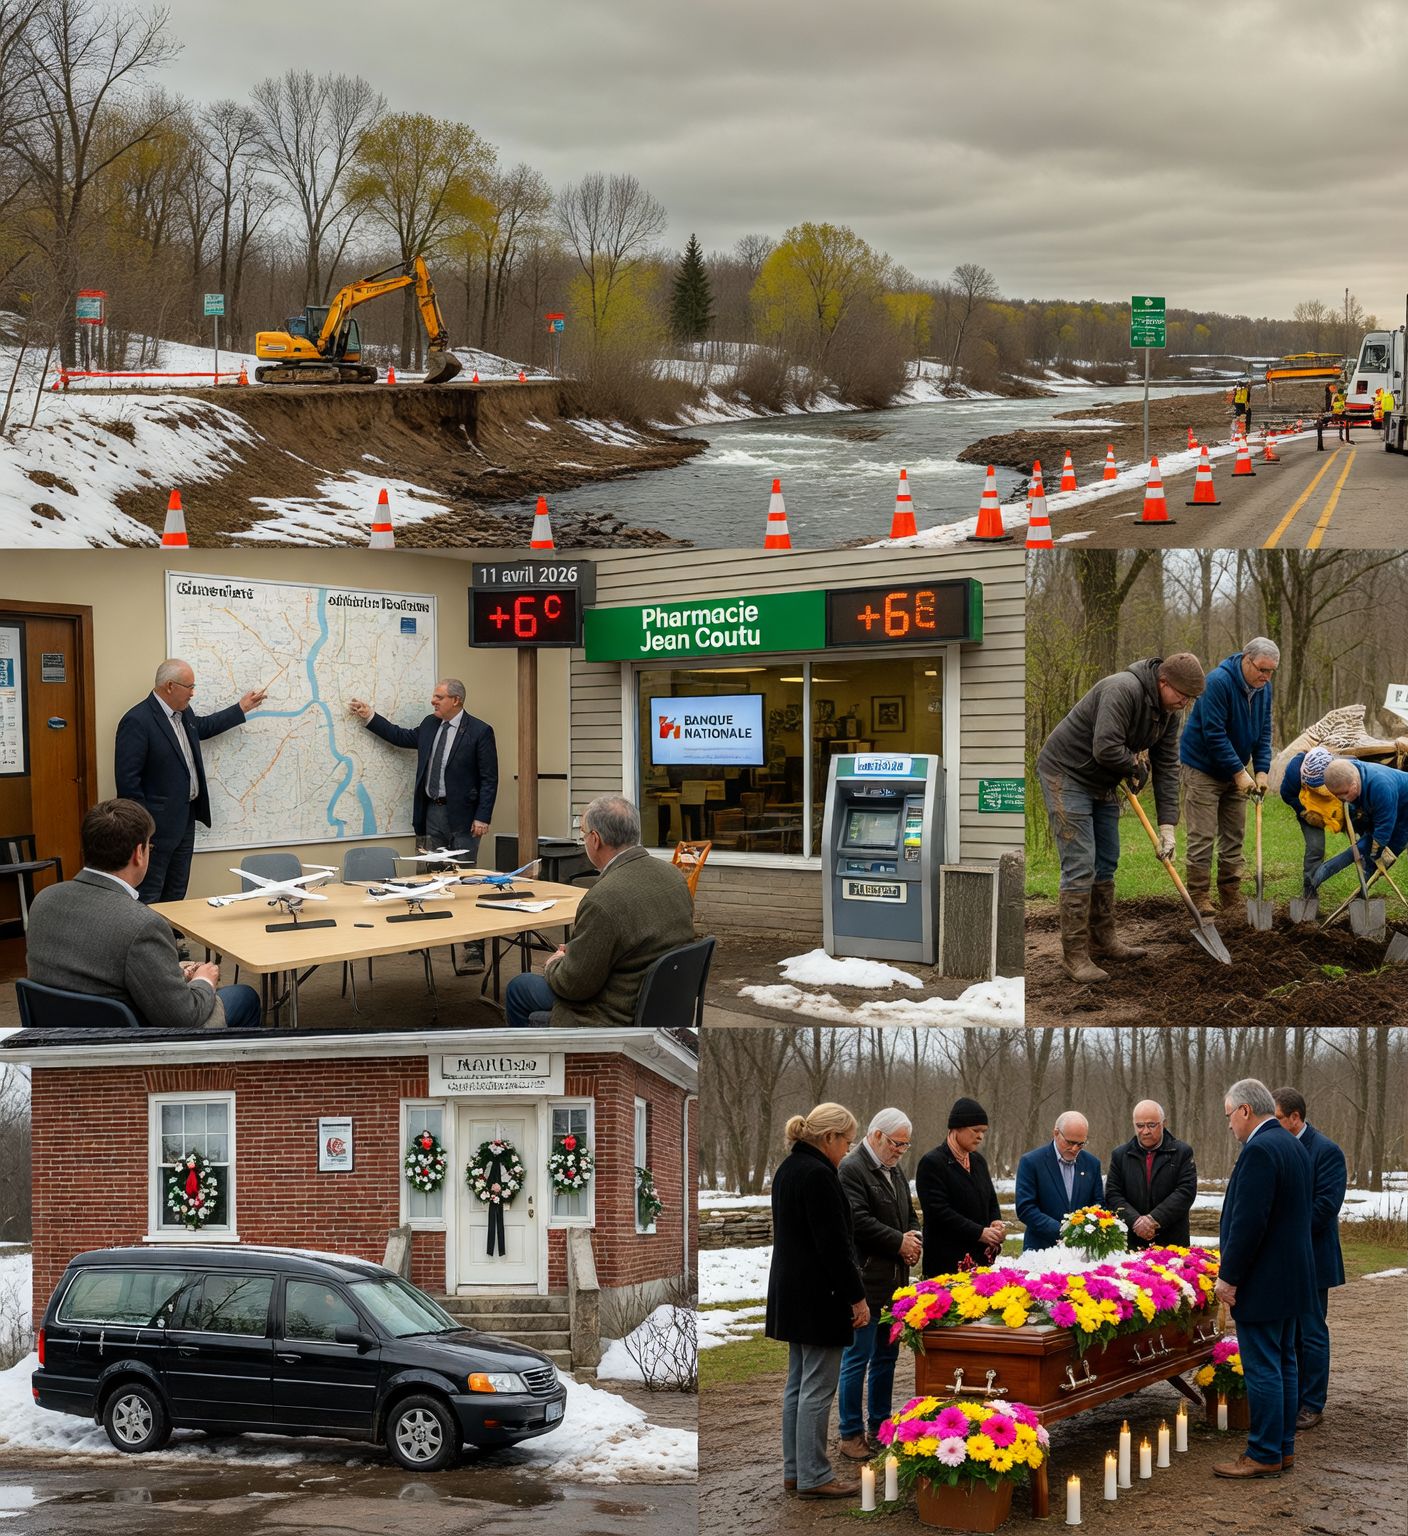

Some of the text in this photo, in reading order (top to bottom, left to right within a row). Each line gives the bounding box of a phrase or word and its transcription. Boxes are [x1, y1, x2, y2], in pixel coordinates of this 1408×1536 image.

[481, 566, 578, 583] 11 avril 2026
[642, 600, 759, 629] Pharmacie
[640, 625, 760, 652] Jean Coutu
[684, 715, 733, 726] BANQUE
[684, 727, 752, 739] NATIONALE
